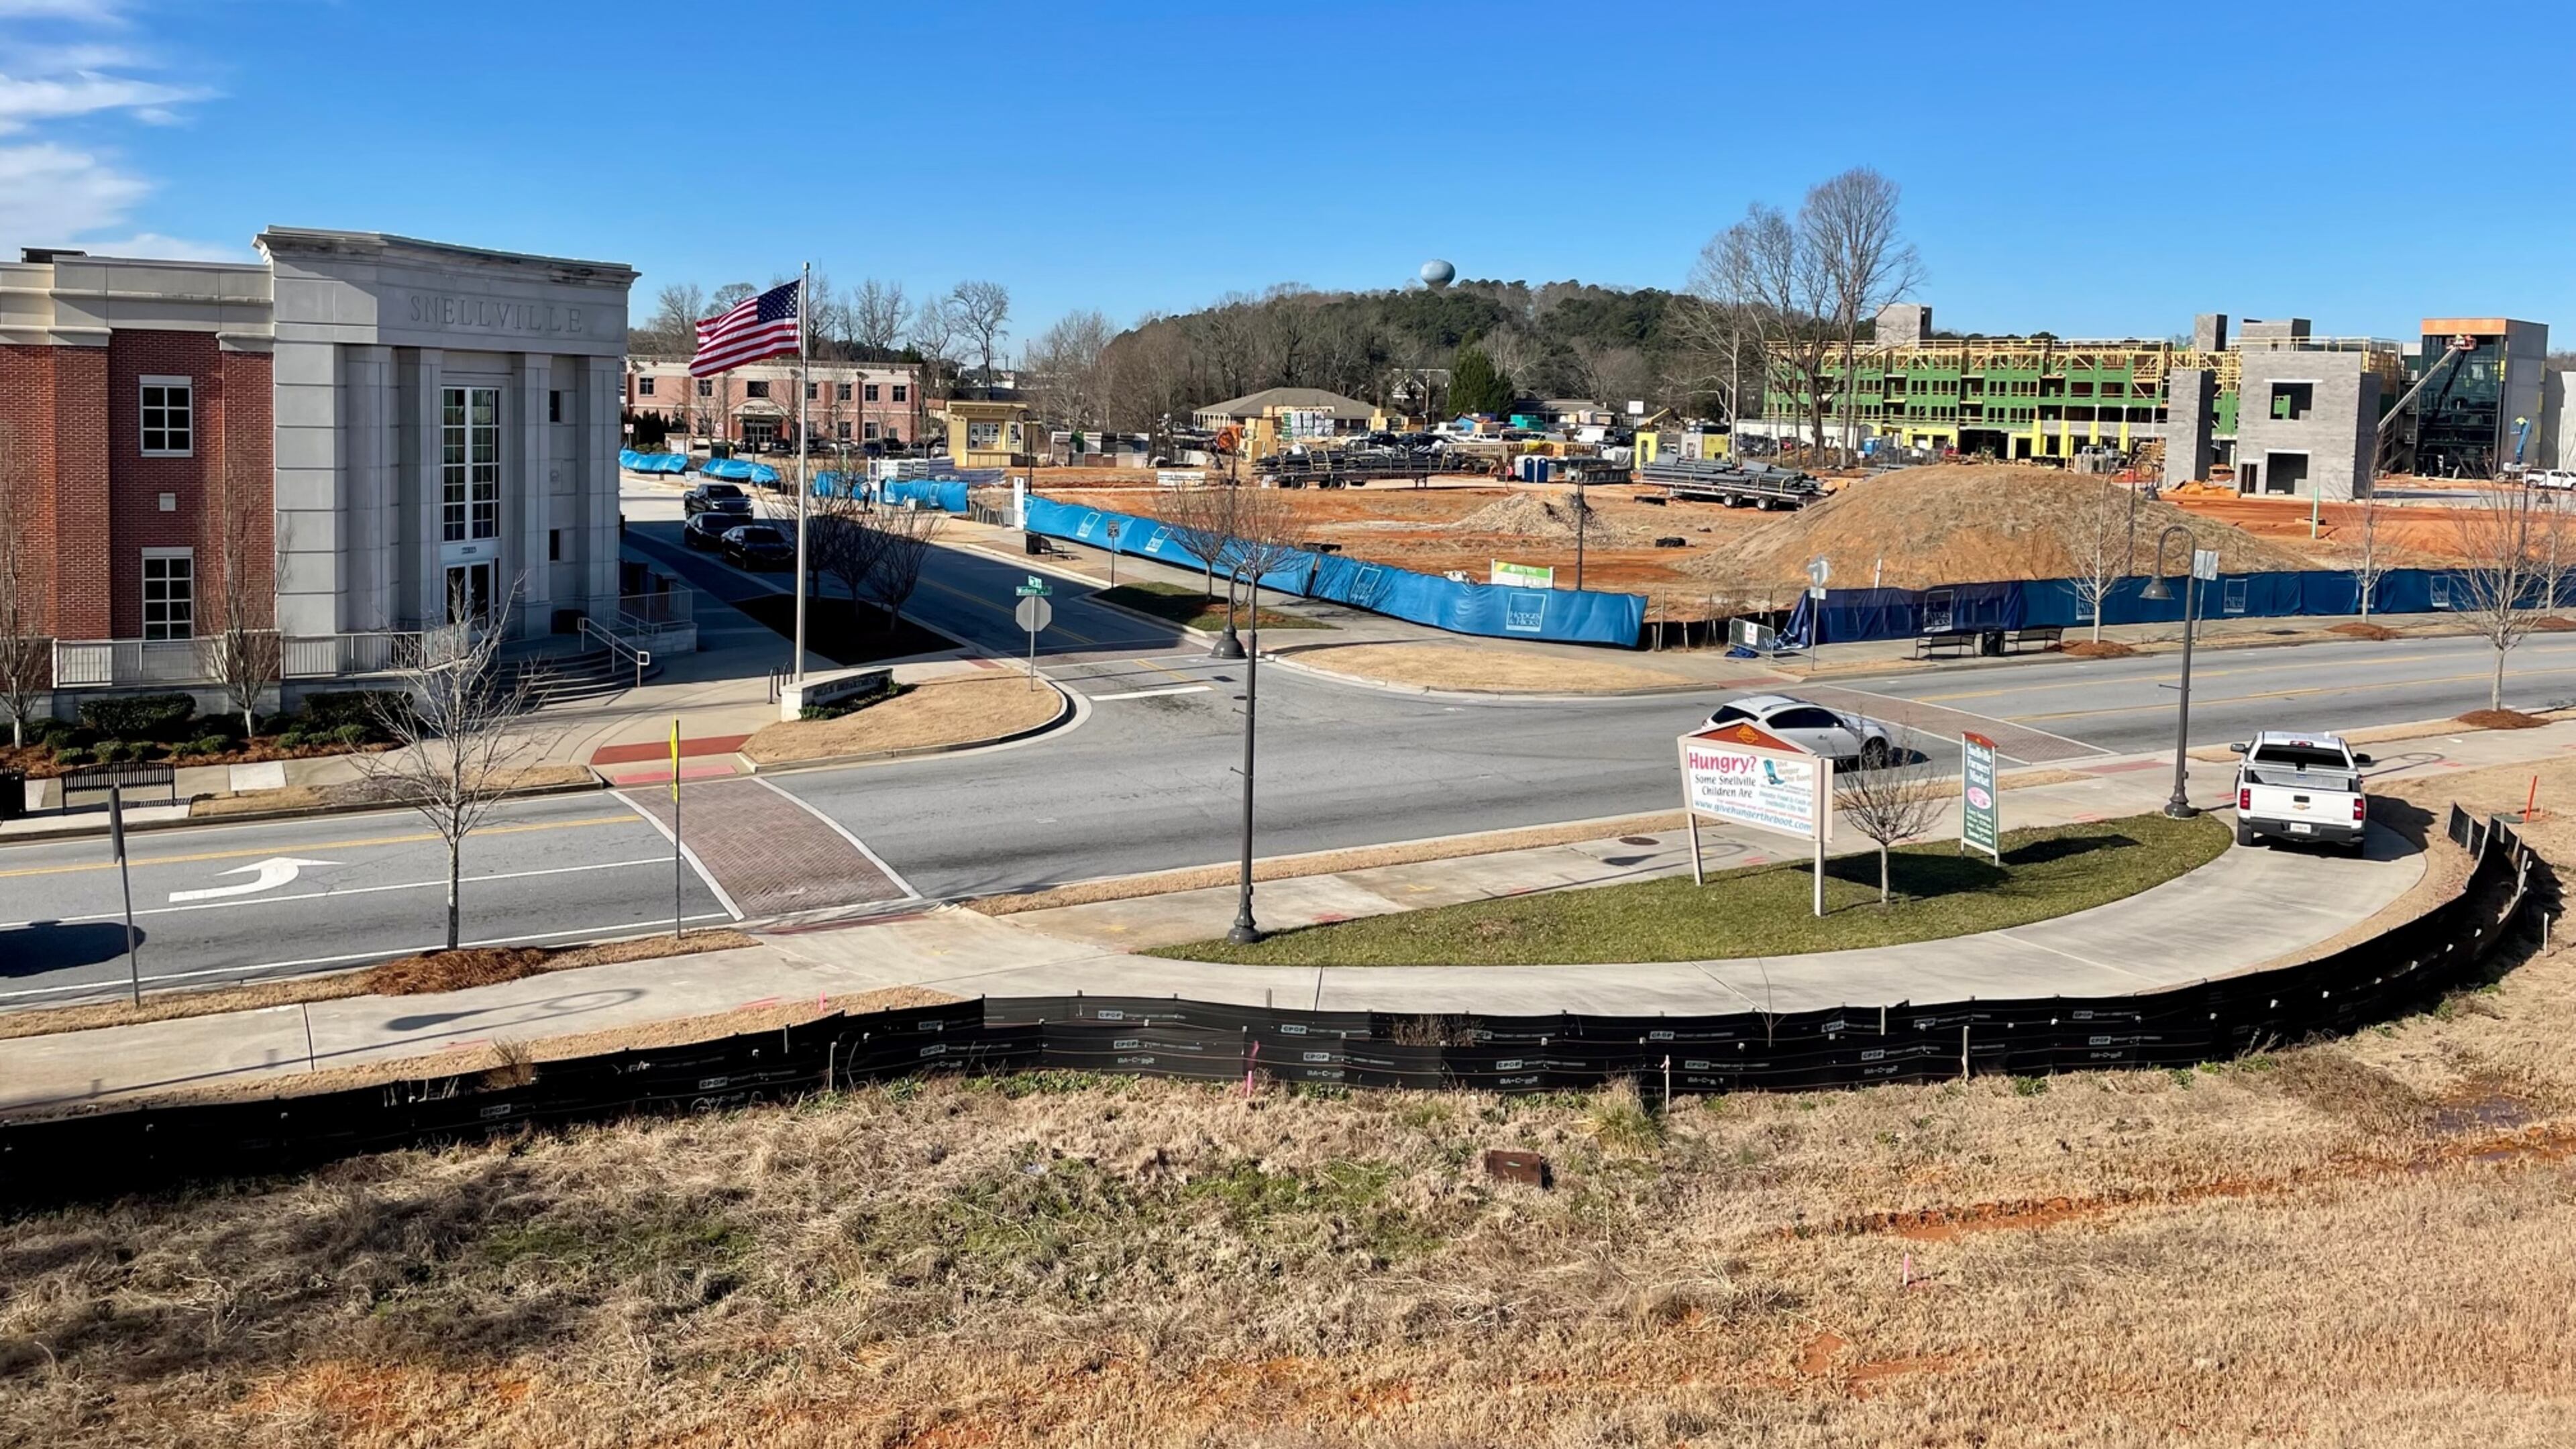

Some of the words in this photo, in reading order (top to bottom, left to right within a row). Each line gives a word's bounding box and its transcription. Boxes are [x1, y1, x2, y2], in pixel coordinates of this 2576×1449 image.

[411, 295, 582, 333] SNELLVILLE
[1689, 753, 1757, 773] Hungry?
[1695, 774, 1716, 785] Some
[1719, 775, 1756, 787] Snellville
[1702, 787, 1736, 796] Children
[1739, 788, 1753, 798] Are
[1695, 799, 1812, 831] www.givehungertheboot.com
